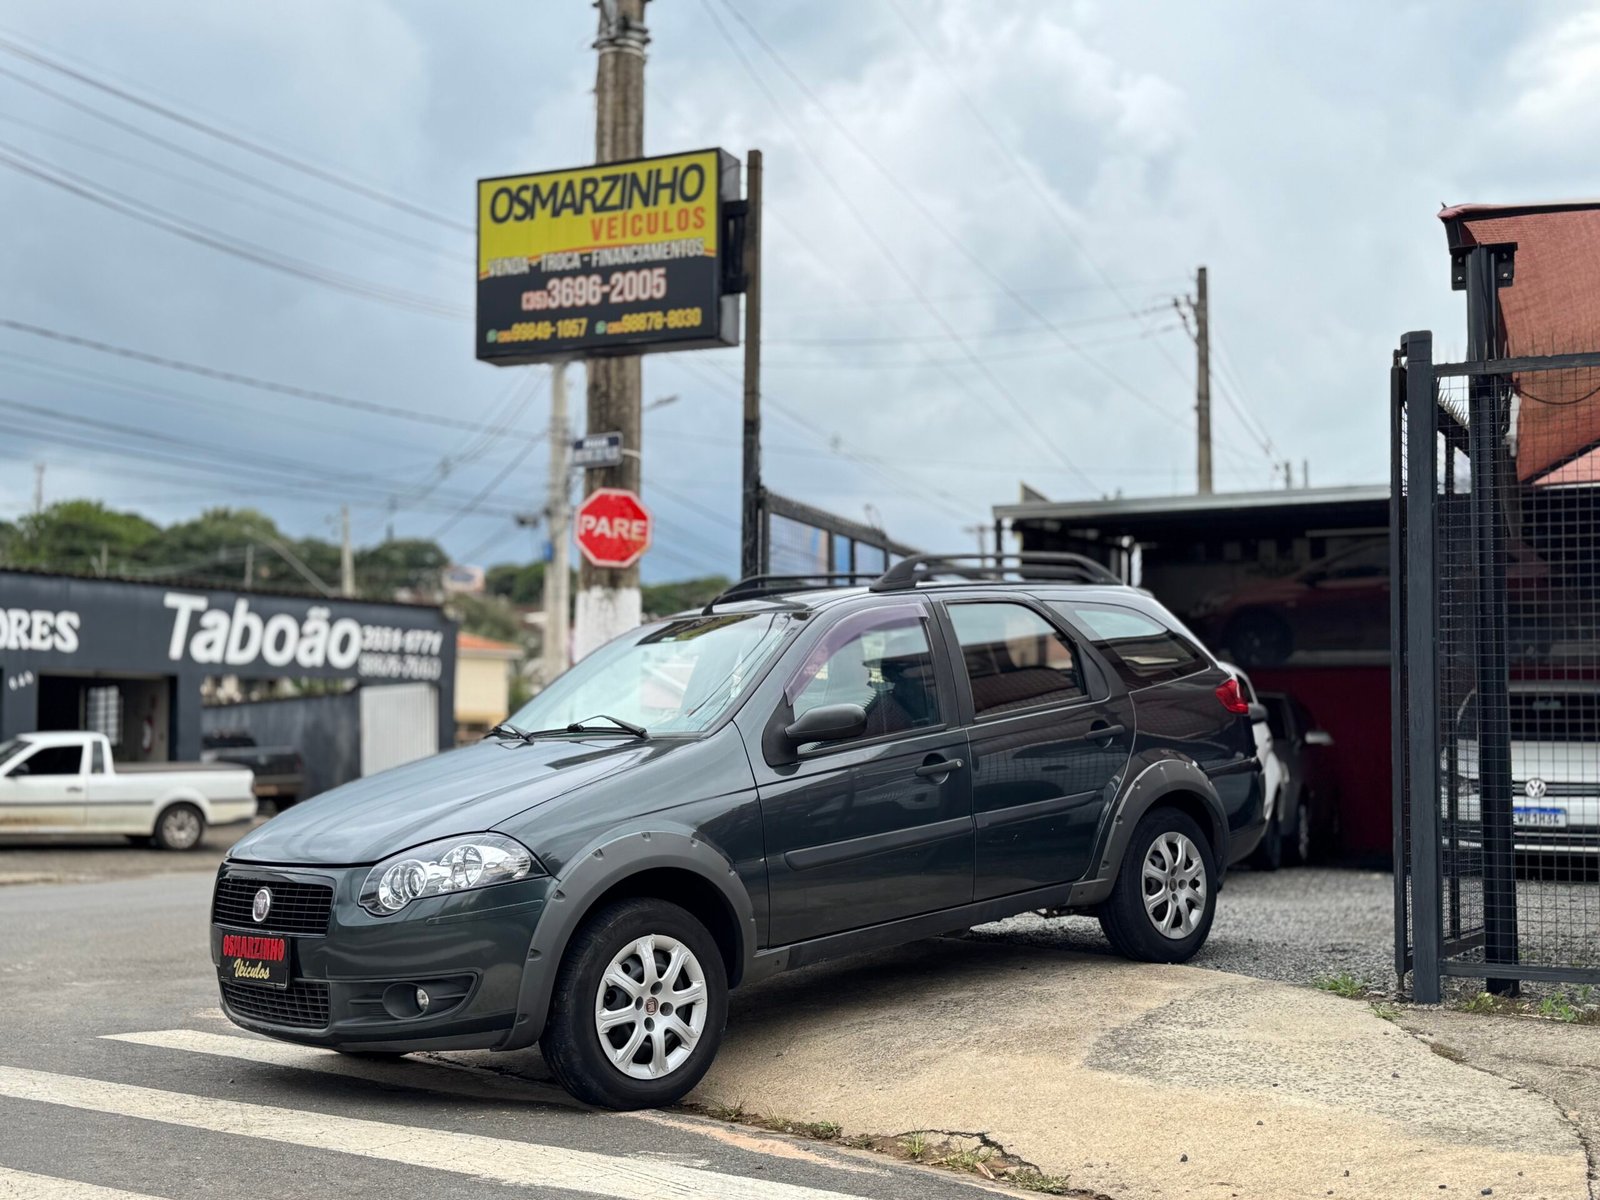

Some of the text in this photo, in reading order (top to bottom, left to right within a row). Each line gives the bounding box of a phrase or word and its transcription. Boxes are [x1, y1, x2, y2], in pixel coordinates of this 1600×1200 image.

[490, 163, 705, 224] OSMARZINHO
[590, 206, 705, 241] VEÍCULOS
[541, 252, 582, 272] TROCA
[591, 238, 705, 267] FINANCIAMENTOS
[579, 514, 646, 541] PARE
[163, 591, 362, 670] Taboão
[223, 934, 285, 961] OSMARZINHO
